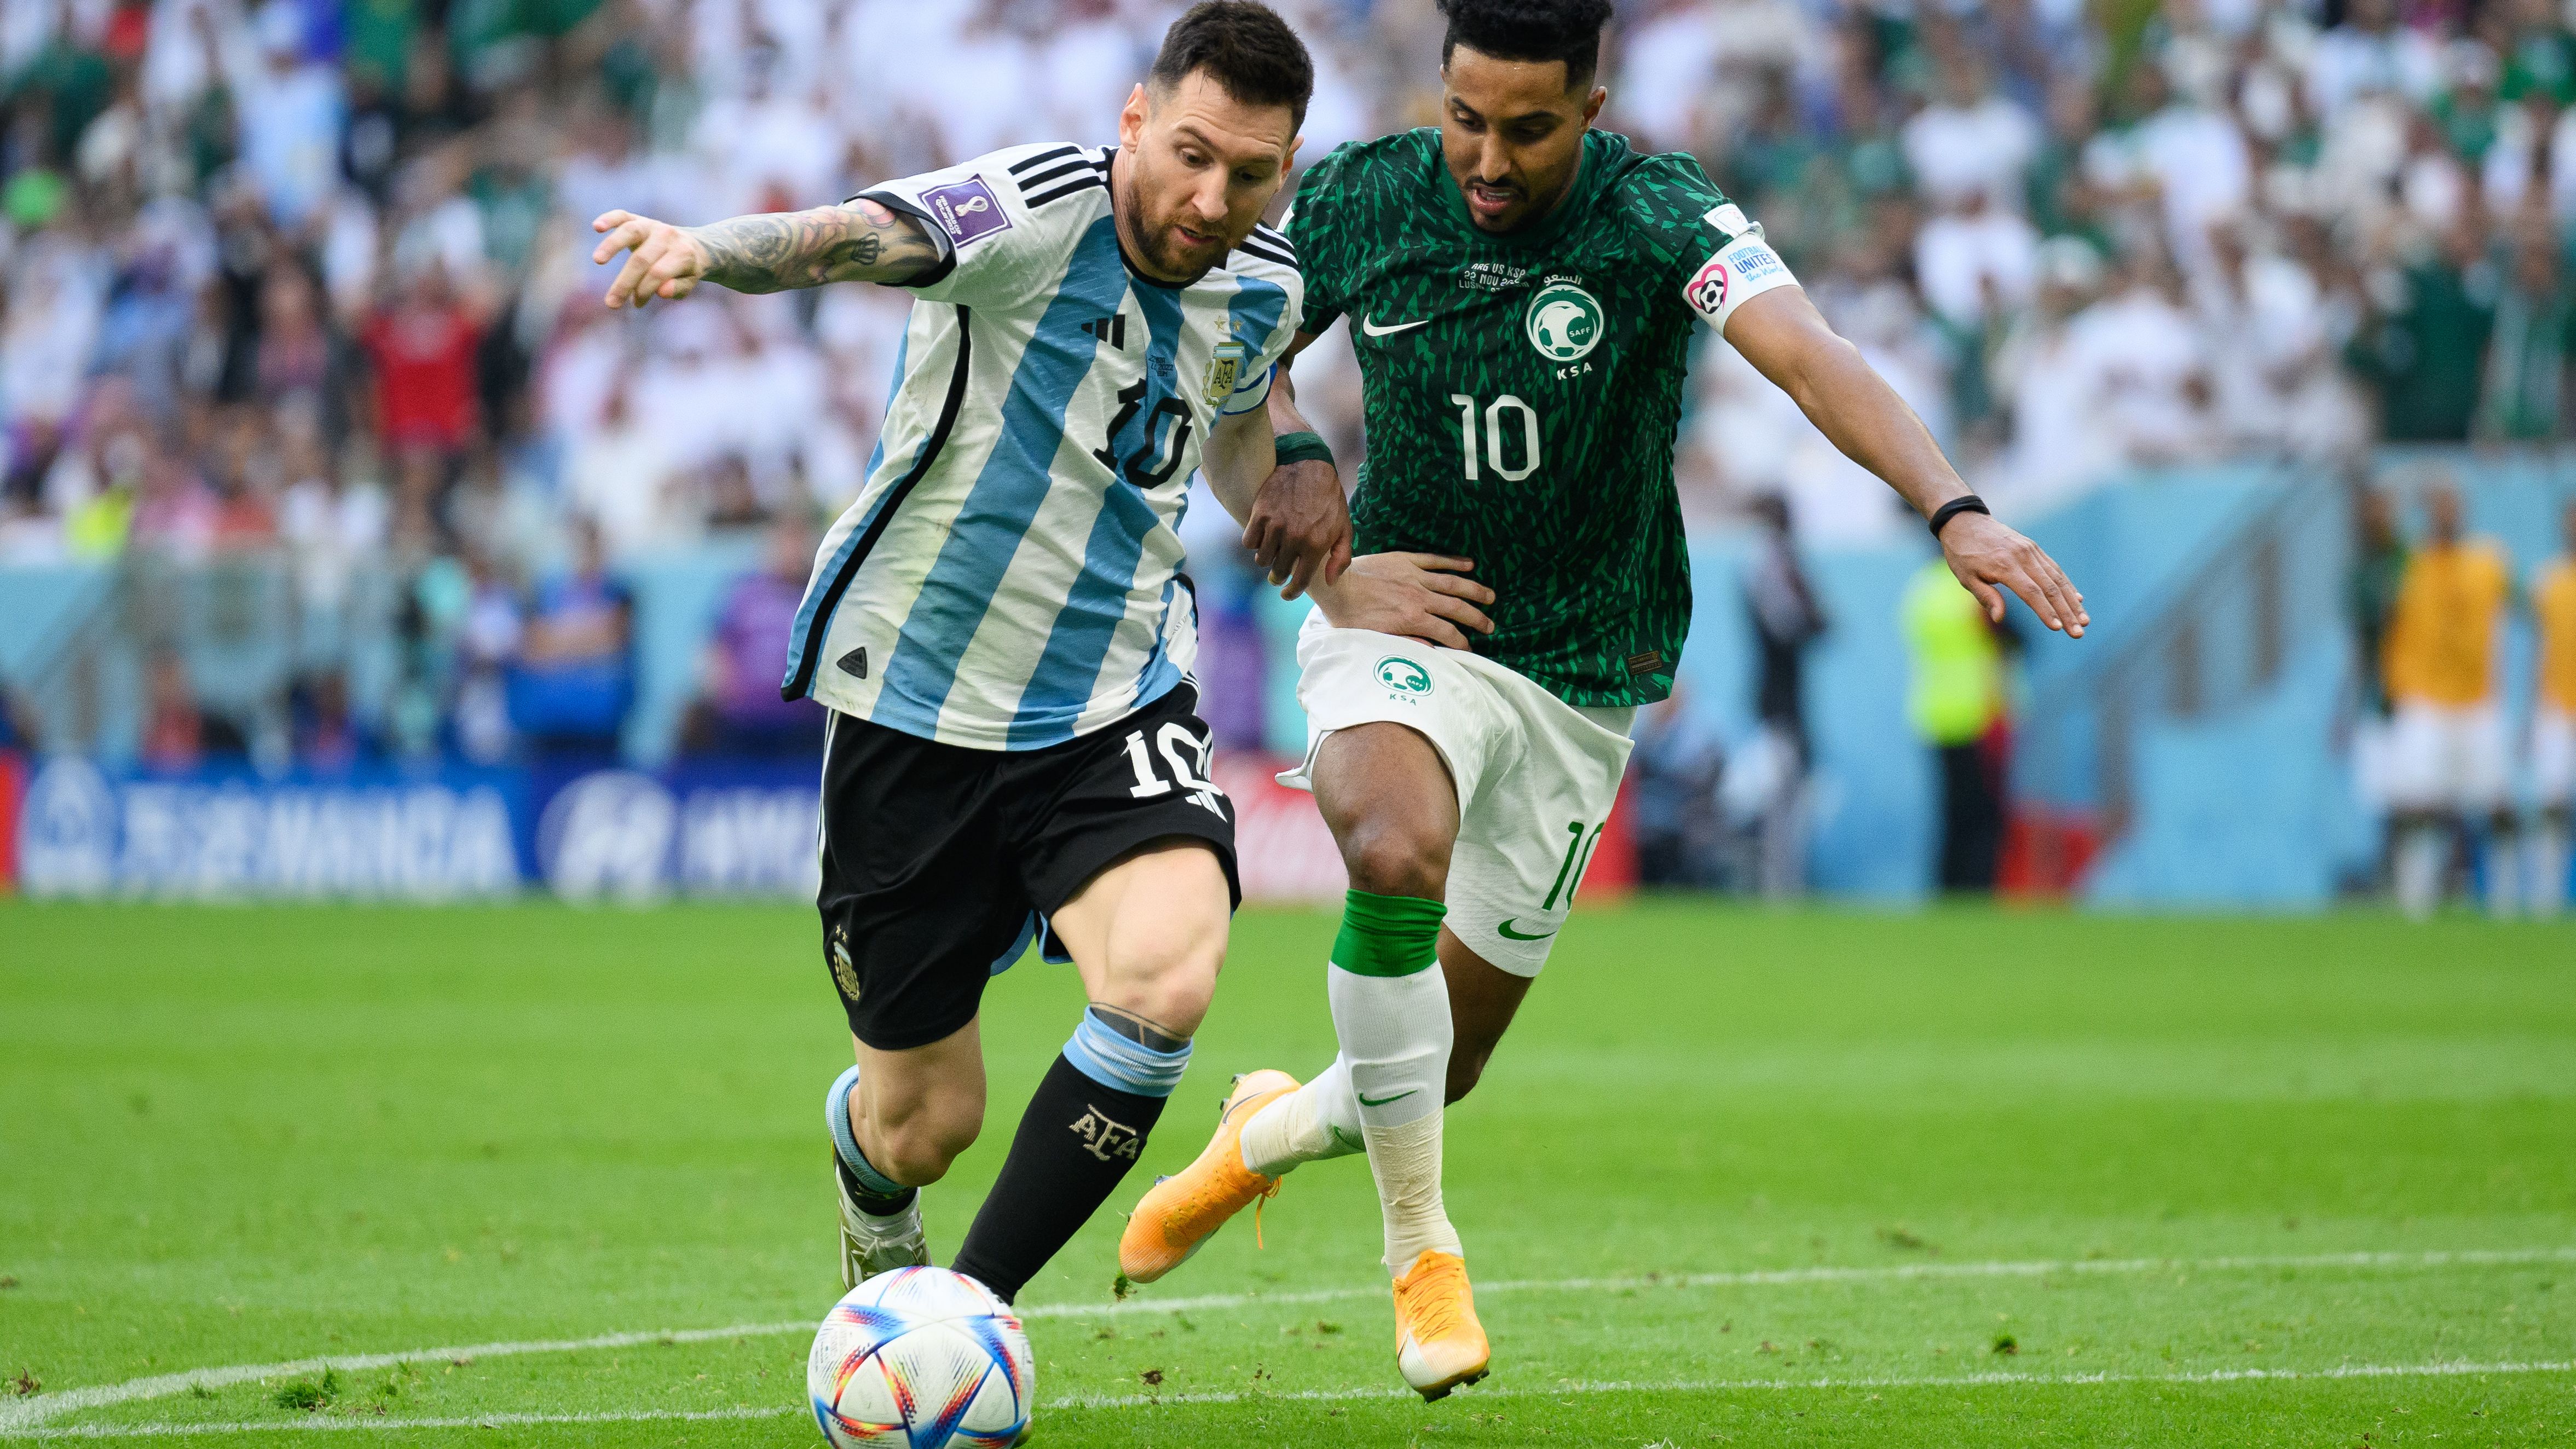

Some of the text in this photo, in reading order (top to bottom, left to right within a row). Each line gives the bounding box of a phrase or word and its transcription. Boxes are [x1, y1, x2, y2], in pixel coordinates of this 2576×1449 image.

[1728, 245, 1767, 263] FOOTBALL
[1734, 253, 1776, 274] UNITES
[1464, 270, 1476, 281] 22
[1471, 263, 1490, 272] ARG
[1569, 326, 1590, 337] SAFF
[1213, 359, 1234, 389] AFA
[1557, 362, 1593, 380] KSA
[1093, 378, 1193, 490] 10
[1452, 394, 1540, 481] 10
[1389, 694, 1417, 706] KSA
[1120, 722, 1224, 798] 10
[1068, 1103, 1140, 1161] AFA
